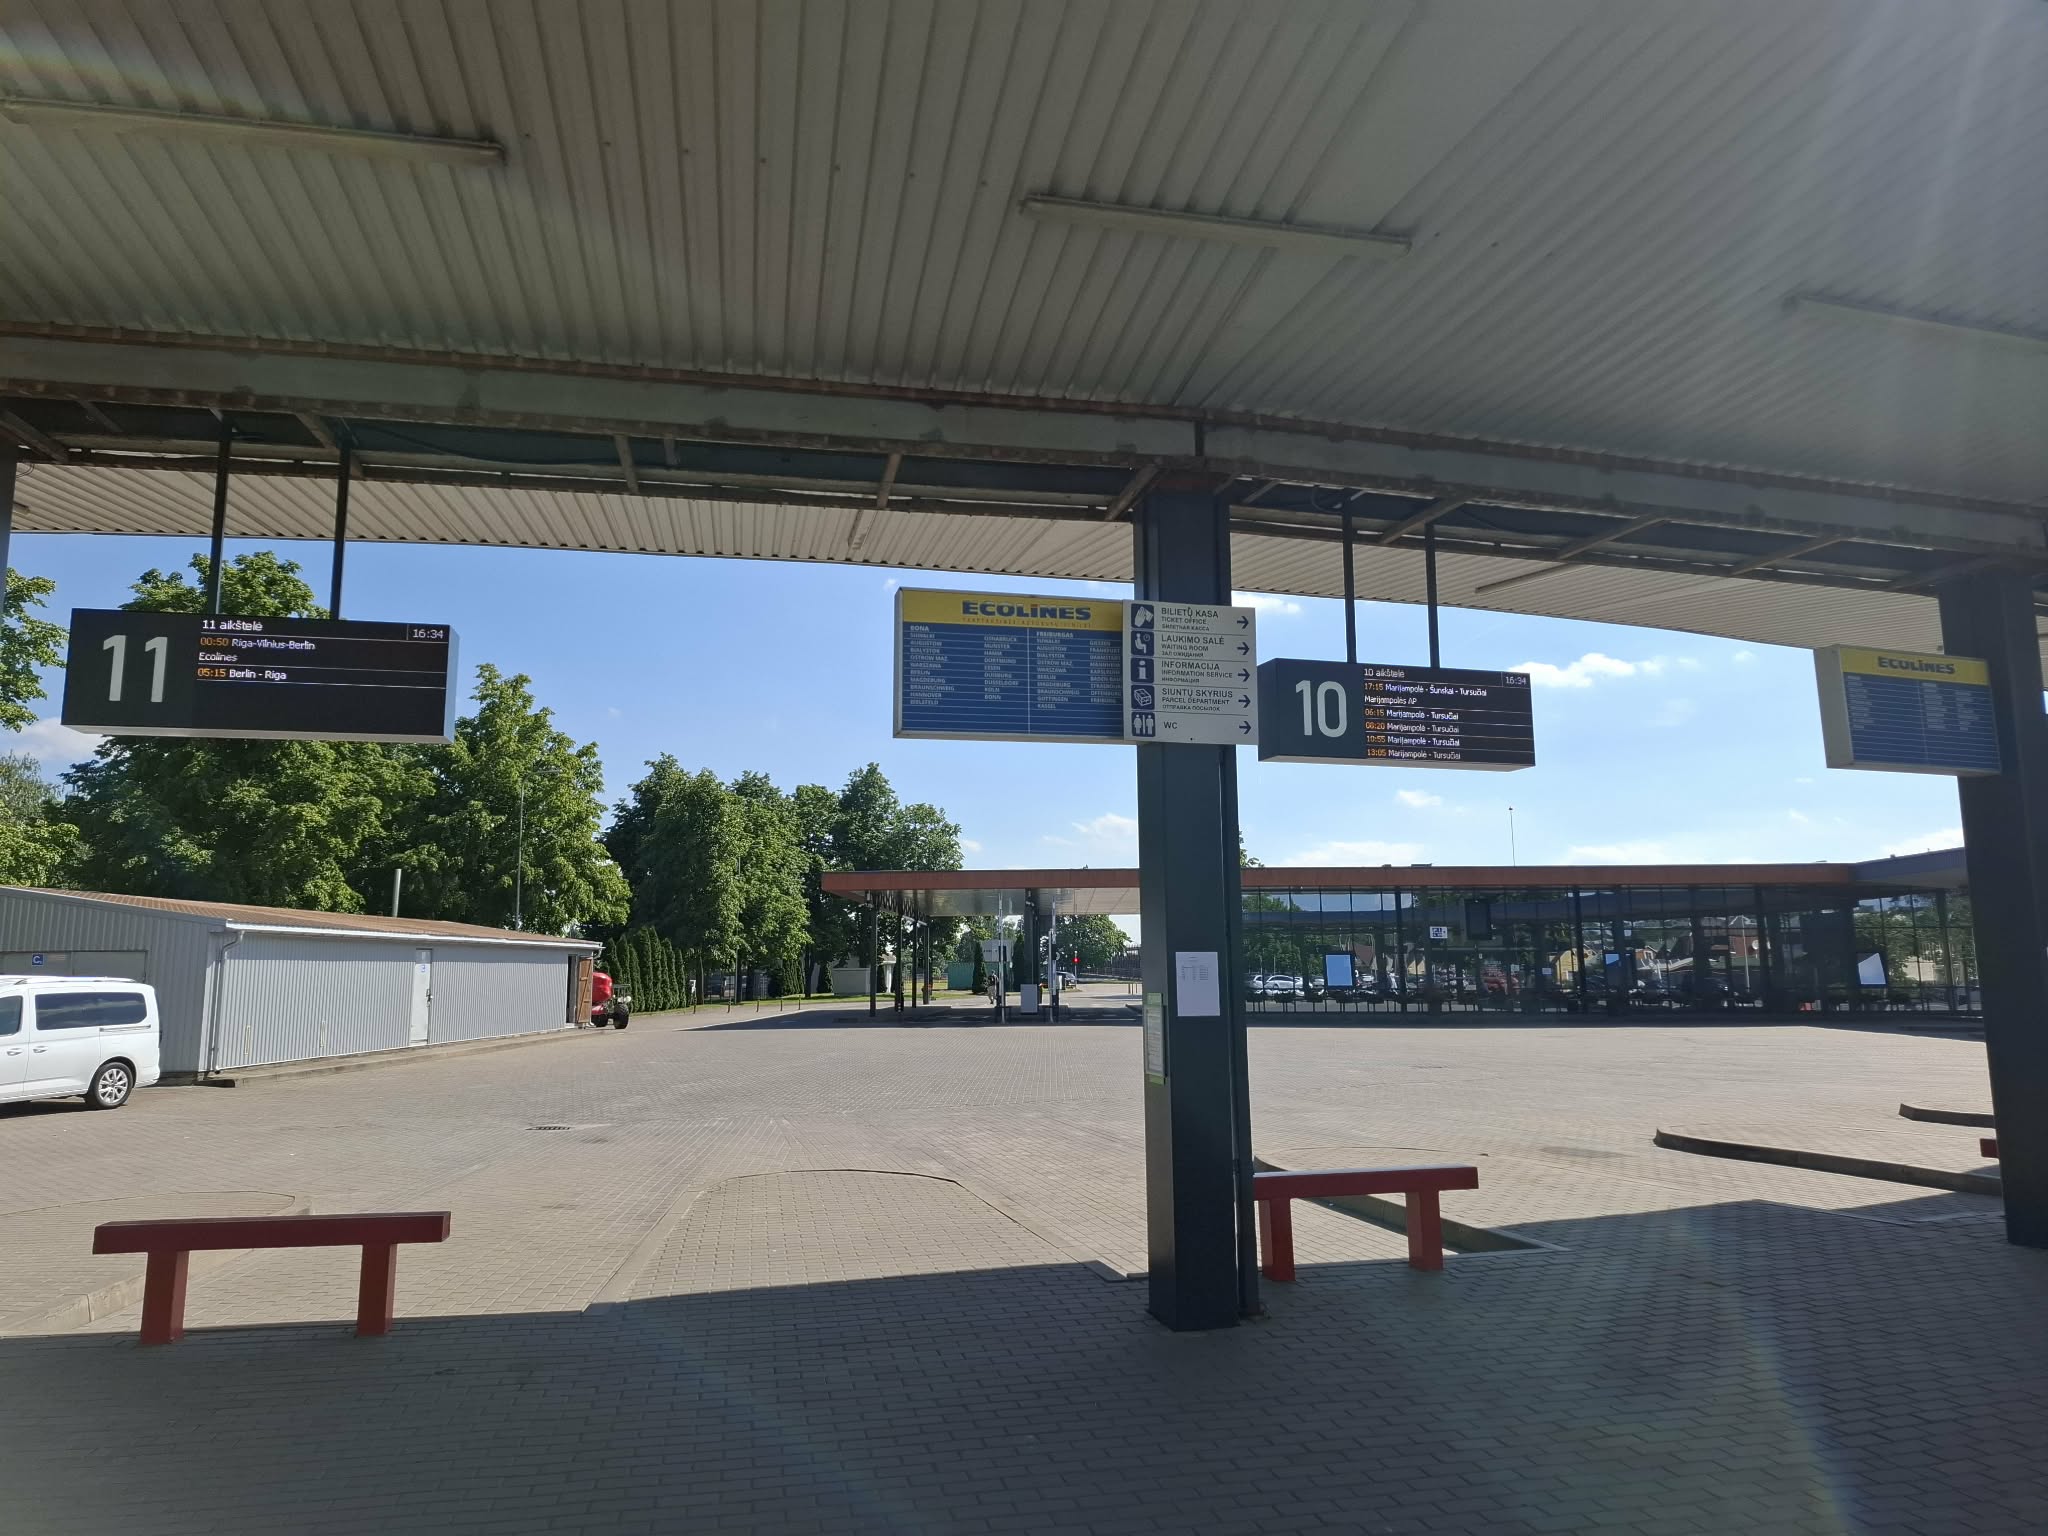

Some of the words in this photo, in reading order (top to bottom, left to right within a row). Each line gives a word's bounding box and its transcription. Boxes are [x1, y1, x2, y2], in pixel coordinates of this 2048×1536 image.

[962, 601, 1091, 620] ECOLINES
[1161, 607, 1193, 618] BILIETŲ
[1195, 609, 1219, 618] KASA
[202, 620, 216, 630] 11
[220, 620, 263, 632] aikštelė
[412, 628, 444, 639] 16:34
[1161, 633, 1201, 644] LAUKIMO
[1202, 635, 1225, 645] SALĖ
[200, 637, 229, 647] 00:50
[1161, 643, 1188, 651] WAITING
[199, 651, 238, 662] Ecolines
[103, 634, 167, 702] 11
[1161, 660, 1221, 671] INFORMACIJA
[1878, 656, 1956, 675] ECOLINES
[197, 667, 226, 678] 05:15
[229, 668, 257, 679] Berlin
[264, 669, 287, 681] Riga
[1161, 669, 1205, 677] INFORMATION
[1364, 668, 1374, 677] 10
[1505, 676, 1527, 685] 16:34
[1161, 687, 1193, 698] SIUNTŲ
[1195, 689, 1233, 698] SKYRIUS
[1364, 683, 1384, 691] 17:15
[1161, 696, 1186, 704] PARCEL
[1295, 679, 1348, 738] 10
[1365, 708, 1384, 717] 06:15
[1163, 721, 1178, 729] WC
[1366, 735, 1386, 743] 10:55
